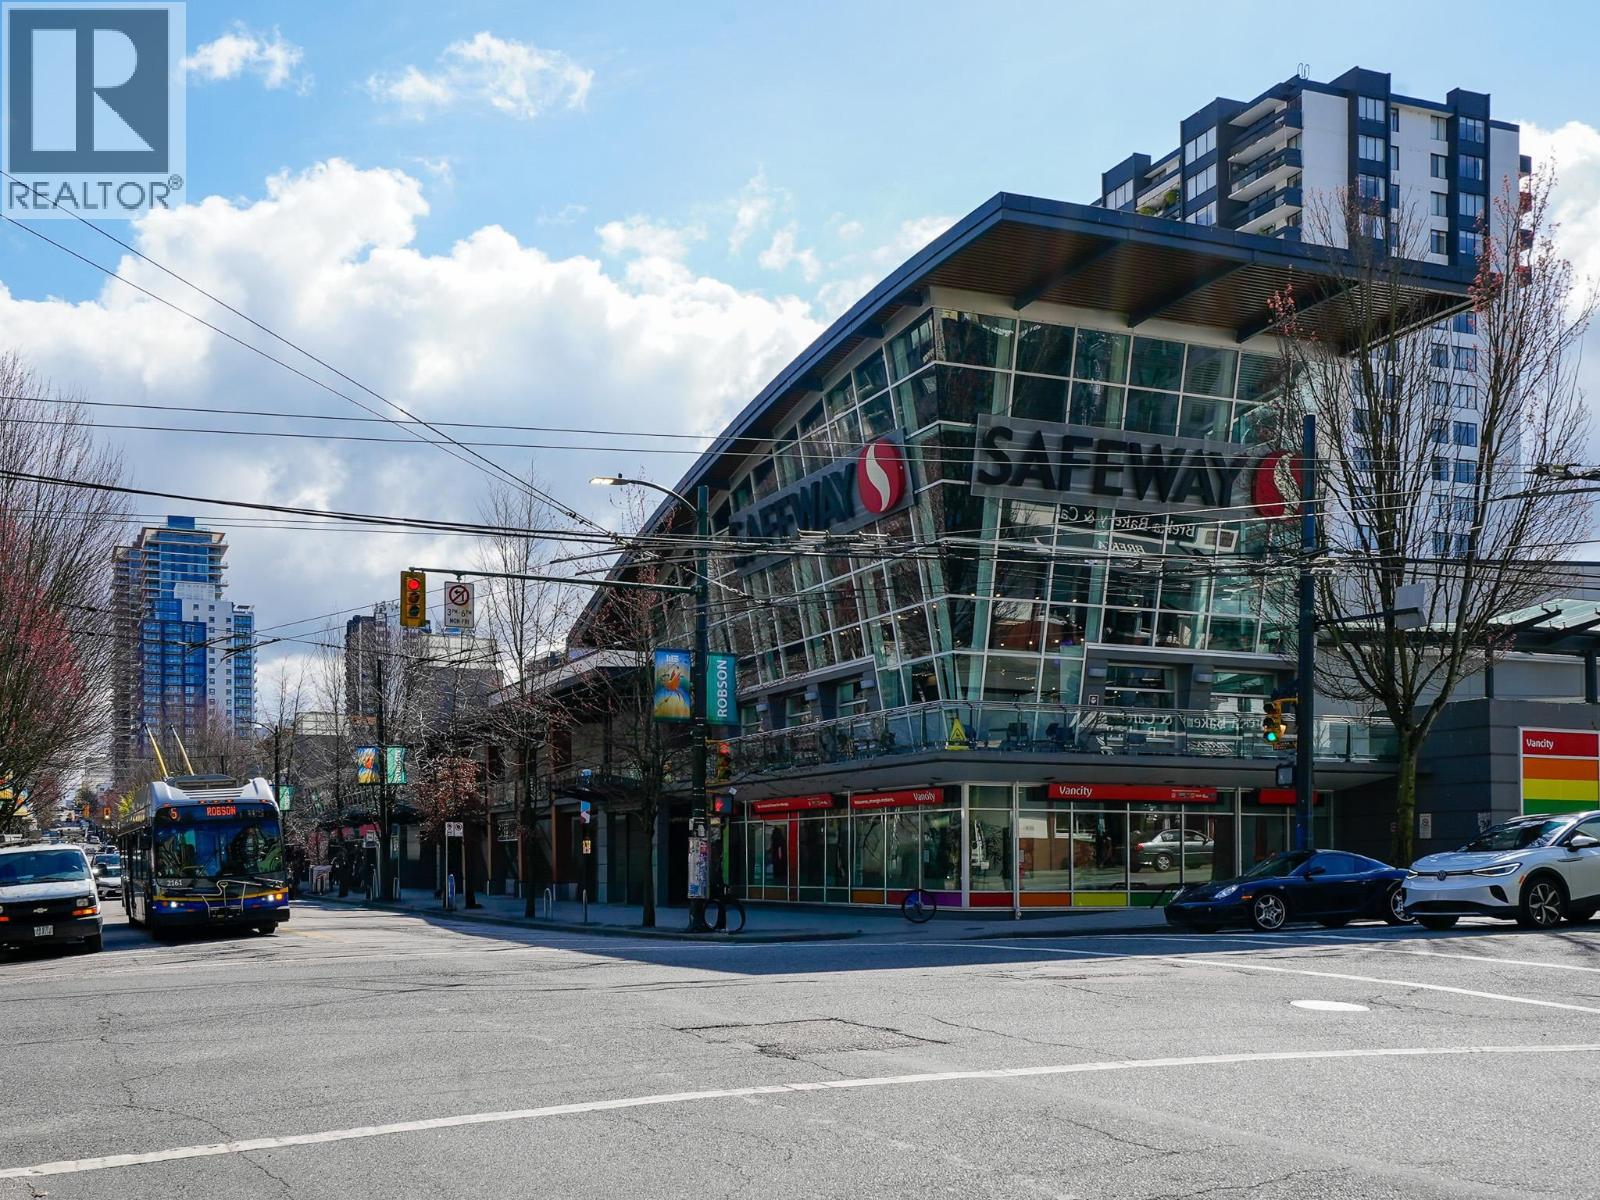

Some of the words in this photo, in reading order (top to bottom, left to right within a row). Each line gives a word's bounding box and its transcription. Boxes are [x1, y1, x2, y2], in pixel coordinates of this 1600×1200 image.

[976, 426, 1250, 509] SAFEWAY
[716, 659, 728, 718] ROBSON
[1526, 738, 1554, 750] Vancity
[912, 790, 936, 803] Vancity
[1059, 785, 1093, 798] Vancity
[170, 807, 178, 820] 5
[206, 805, 237, 817] ROBSON
[167, 879, 183, 887] 2161
